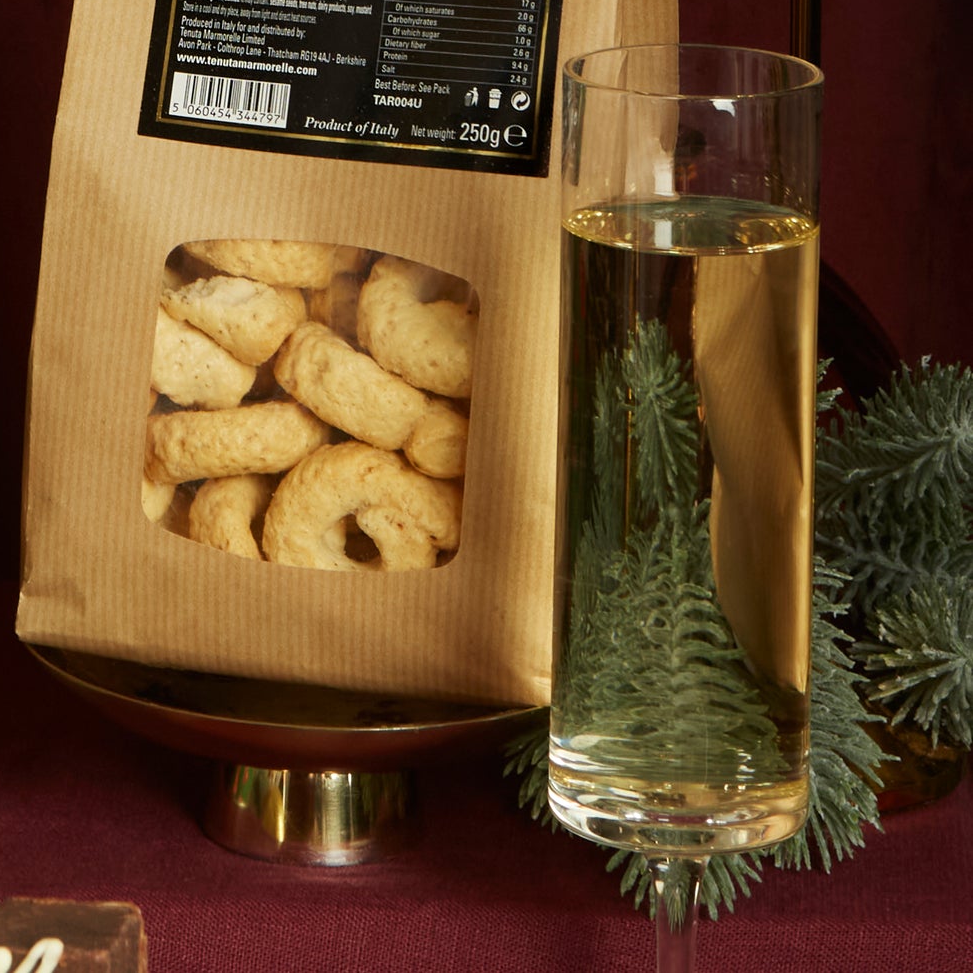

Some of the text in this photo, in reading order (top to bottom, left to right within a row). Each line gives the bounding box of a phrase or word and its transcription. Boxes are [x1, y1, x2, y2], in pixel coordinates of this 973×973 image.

[395, 3, 404, 12] Of
[404, 4, 424, 13] which
[424, 7, 455, 16] saturates
[522, 0, 529, 7] 17
[181, 15, 306, 40] Produced in Italy for and distributed by:
[387, 14, 438, 26] Carbohydrates
[180, 27, 265, 46] Tenuta Marmorelle Limited
[392, 26, 401, 35] Of
[401, 28, 421, 37] which
[421, 31, 441, 40] sugar
[384, 38, 410, 49] Dietary
[178, 37, 196, 49] Avon
[196, 40, 212, 51] Park
[217, 42, 245, 56] Colthrop
[245, 45, 262, 56] Lane
[268, 47, 299, 60] Thatcham
[300, 49, 317, 62] RG19
[335, 53, 367, 67] Berkshire
[382, 50, 408, 61] Protein
[176, 53, 318, 76] www.tenutamarmorelle.com
[381, 64, 396, 74] Salt
[374, 78, 451, 95] Best Before: See Pack
[372, 94, 423, 109] TAR004U
[172, 102, 281, 125] 5 060454 344797
[304, 116, 399, 139] Product of Italy
[410, 124, 426, 138] Net
[426, 126, 456, 141] weight:
[459, 122, 501, 148] 250g
